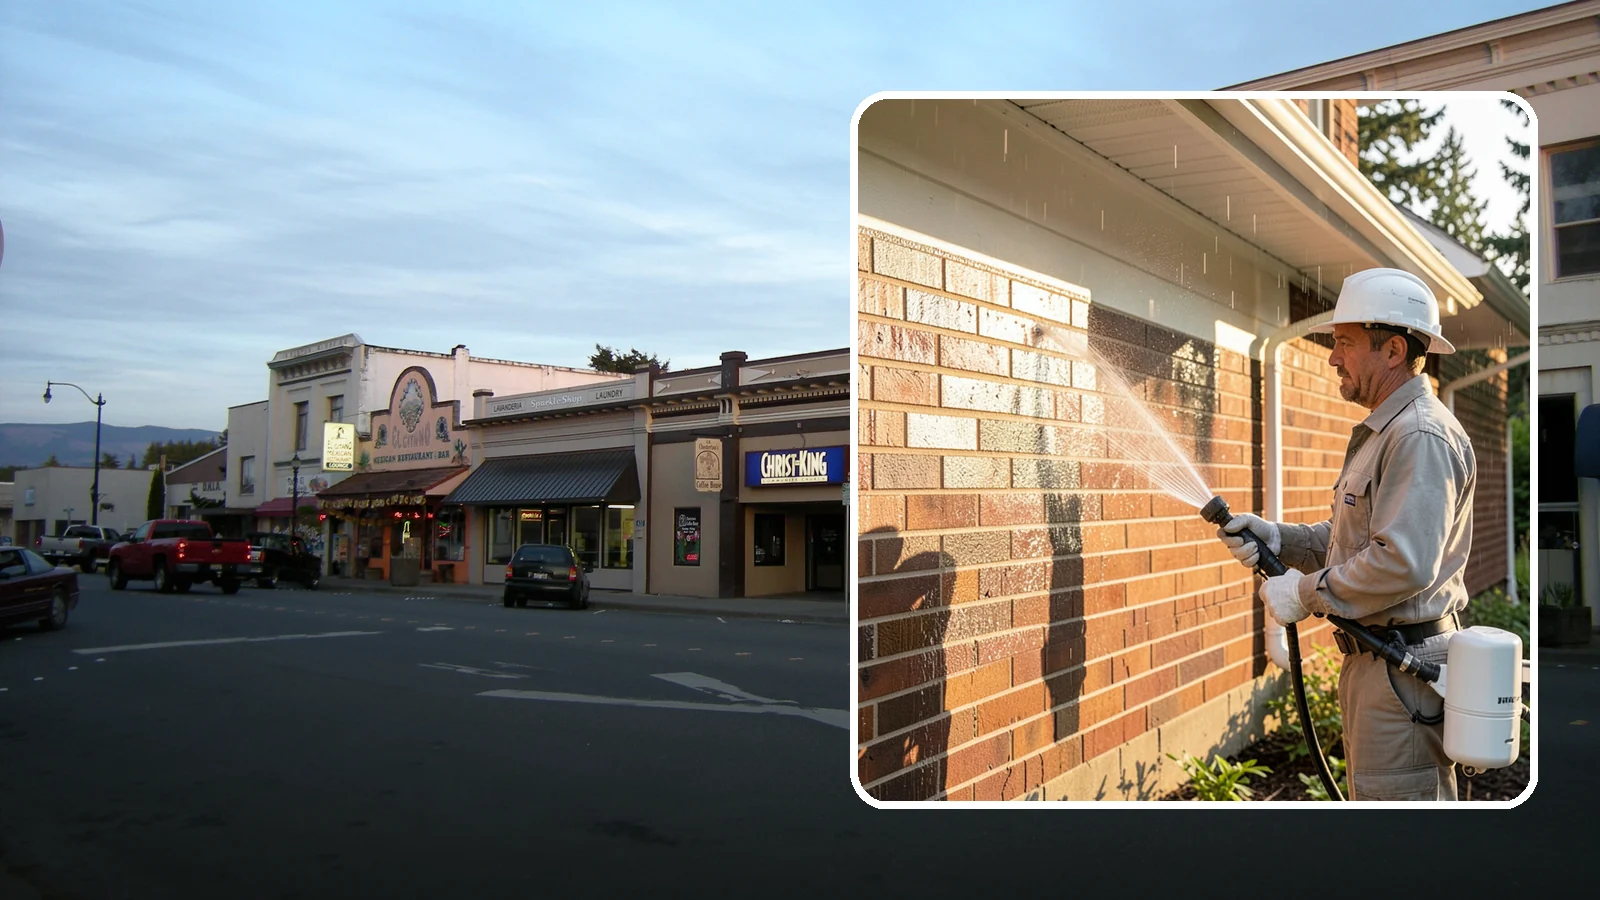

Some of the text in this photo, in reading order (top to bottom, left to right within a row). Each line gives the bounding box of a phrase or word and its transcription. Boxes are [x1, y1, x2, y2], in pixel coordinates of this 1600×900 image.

[595, 389, 623, 400] LAUNDRY
[493, 402, 522, 412] LAVANDERIA
[530, 394, 583, 409] Sparkle Shop
[374, 455, 396, 463] MEXICAN
[397, 451, 433, 462] RESTAURANT
[437, 450, 450, 459] BAR
